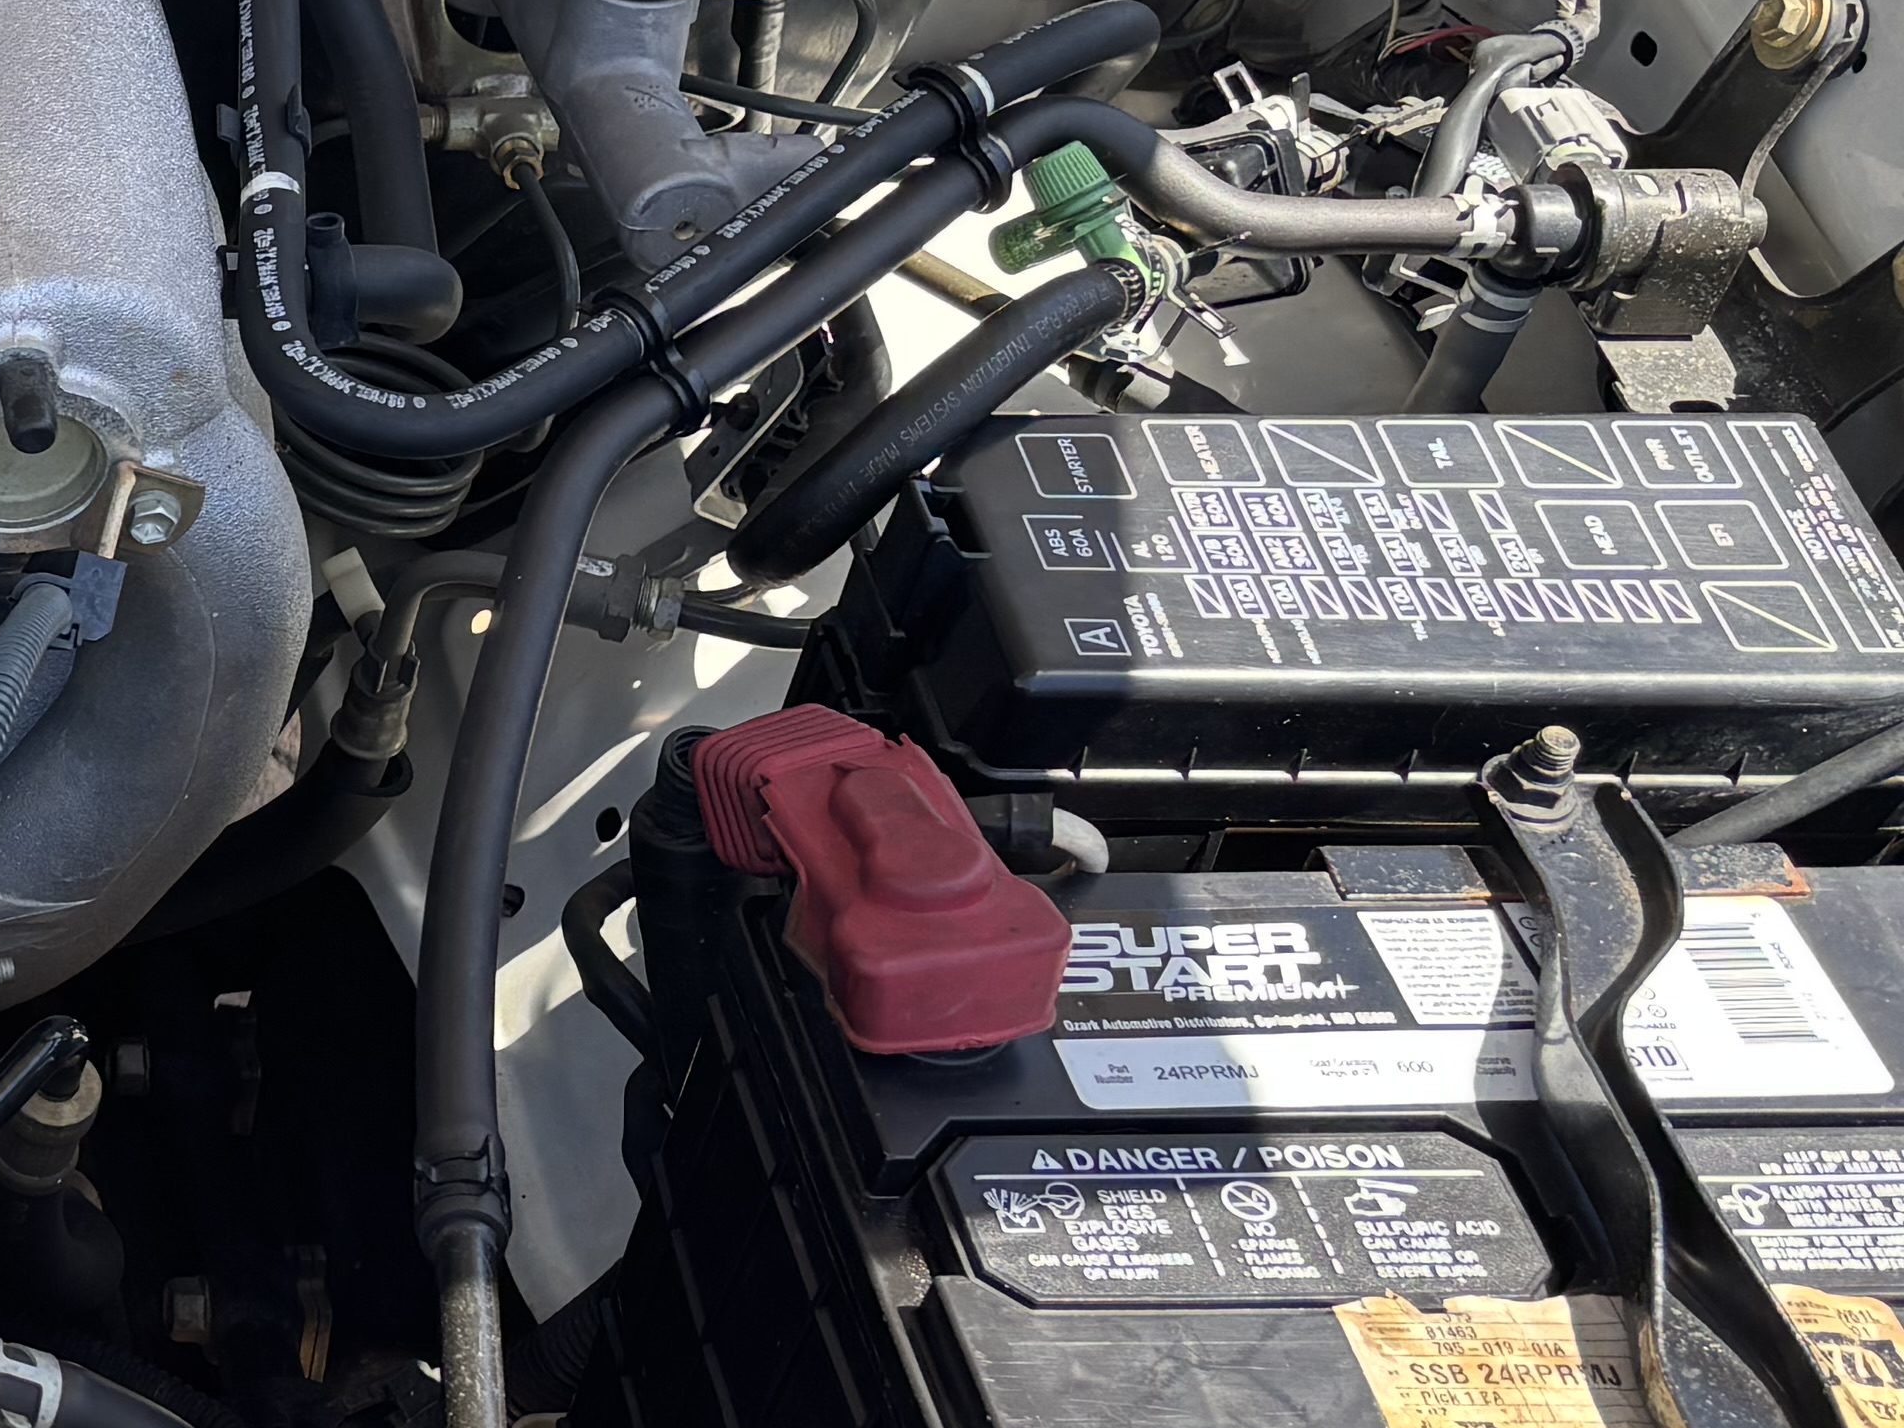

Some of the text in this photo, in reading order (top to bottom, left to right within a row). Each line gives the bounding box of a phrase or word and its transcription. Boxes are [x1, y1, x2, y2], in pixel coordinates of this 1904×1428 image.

[961, 334, 1034, 397] INJECTION
[900, 391, 962, 444] SYSTEMS
[1057, 437, 1095, 494] STARTER
[1184, 424, 1224, 481] HEATER
[1428, 436, 1455, 470] TAIL
[1670, 426, 1716, 484] OUTLET
[1043, 528, 1070, 557] ABS
[1068, 528, 1094, 558] 60A
[1583, 513, 1620, 557] HEAD
[1786, 507, 1830, 562] NOTICE
[1078, 626, 1120, 649] A
[1123, 593, 1163, 658] TOYOTA
[1070, 922, 1311, 959] SUPER
[1059, 950, 1322, 993] START
[1063, 1017, 1100, 1033] Ozark
[1101, 1015, 1173, 1032] Automotive
[1175, 1013, 1255, 1031] Distributors,
[1094, 1073, 1135, 1085] Number
[1107, 1063, 1131, 1075] Part
[1152, 1064, 1260, 1082] 24RPRMJ
[1065, 1143, 1406, 1171] DANGER / POISON
[1096, 1188, 1168, 1206] SHIELD
[1776, 1199, 1827, 1214] WITH
[1104, 1204, 1158, 1221] EYES
[1064, 1219, 1174, 1237] EXPLOSIVE
[1242, 1221, 1277, 1238] NO
[1354, 1220, 1501, 1237] SULFURIC ACID
[1072, 1235, 1141, 1253] GASES
[1408, 1362, 1471, 1386] SSB
